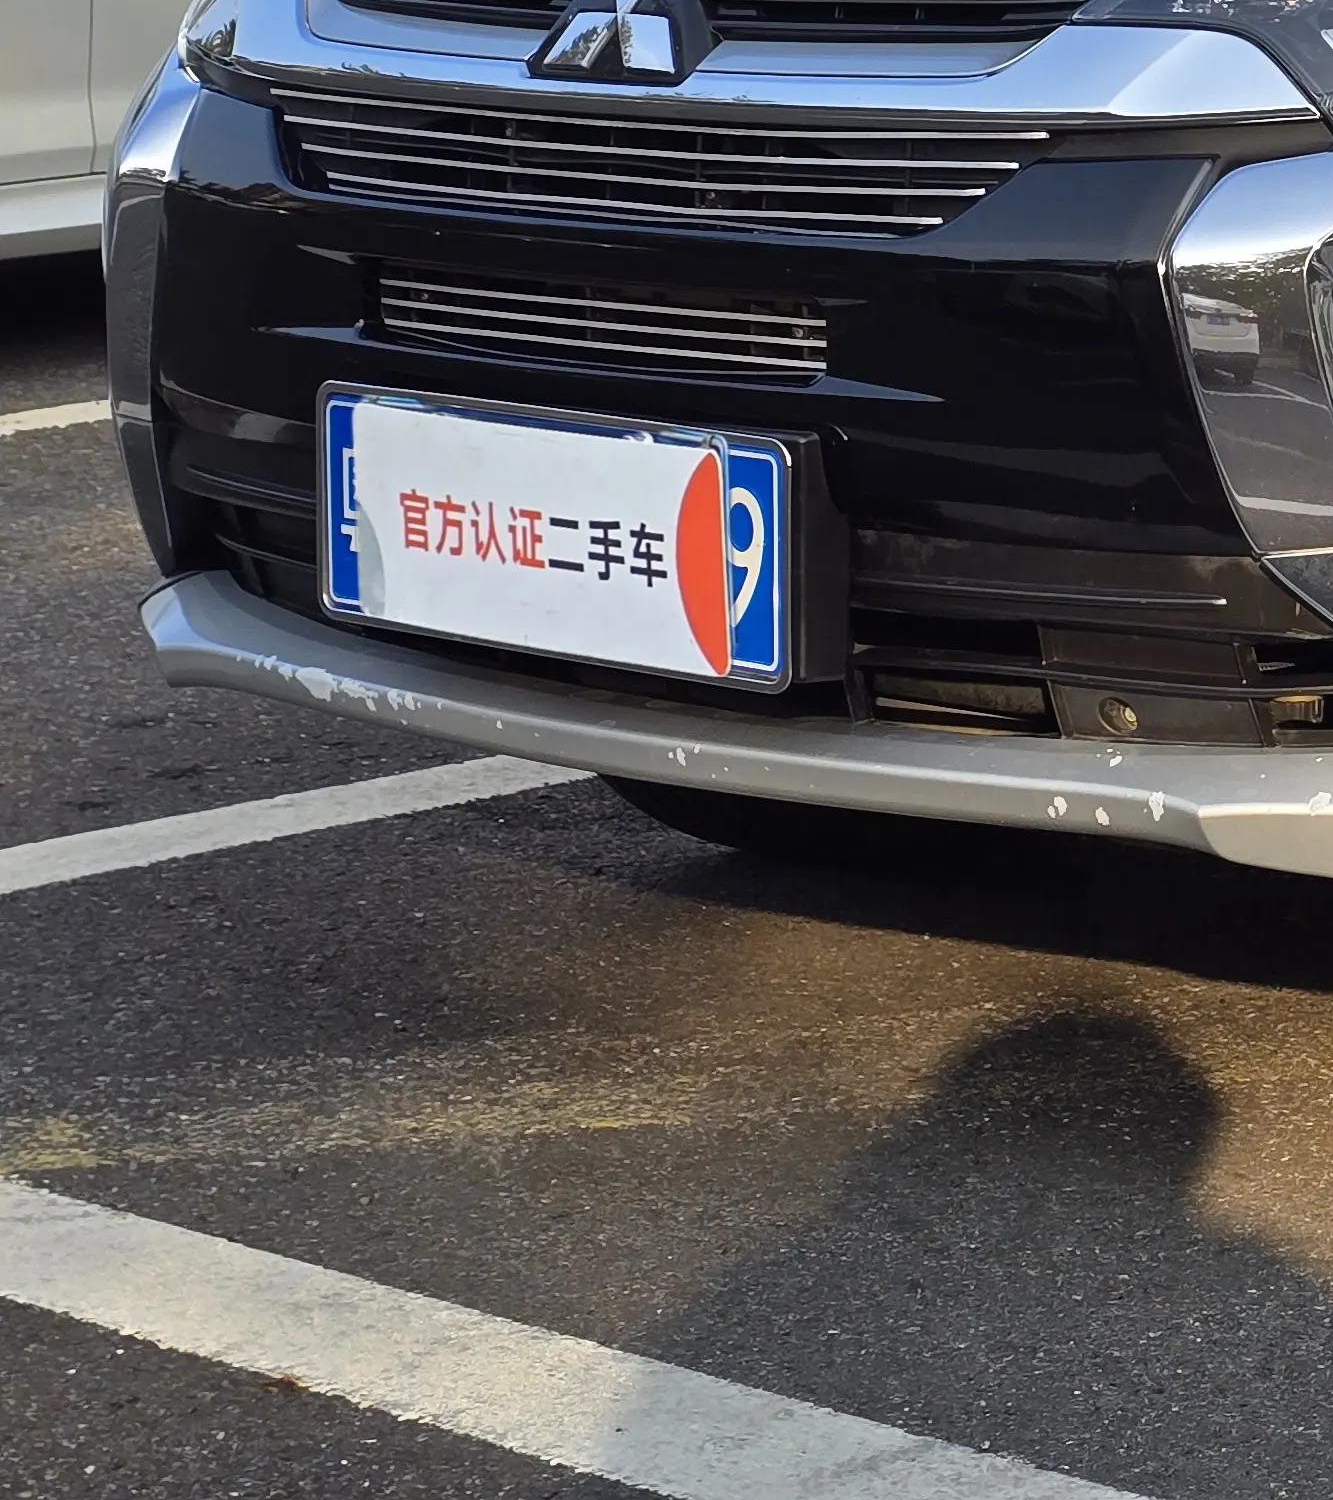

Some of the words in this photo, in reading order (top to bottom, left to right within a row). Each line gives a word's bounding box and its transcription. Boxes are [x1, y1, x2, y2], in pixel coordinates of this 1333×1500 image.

[398, 489, 668, 587] 官方认证二手车
[728, 487, 764, 627] 9
